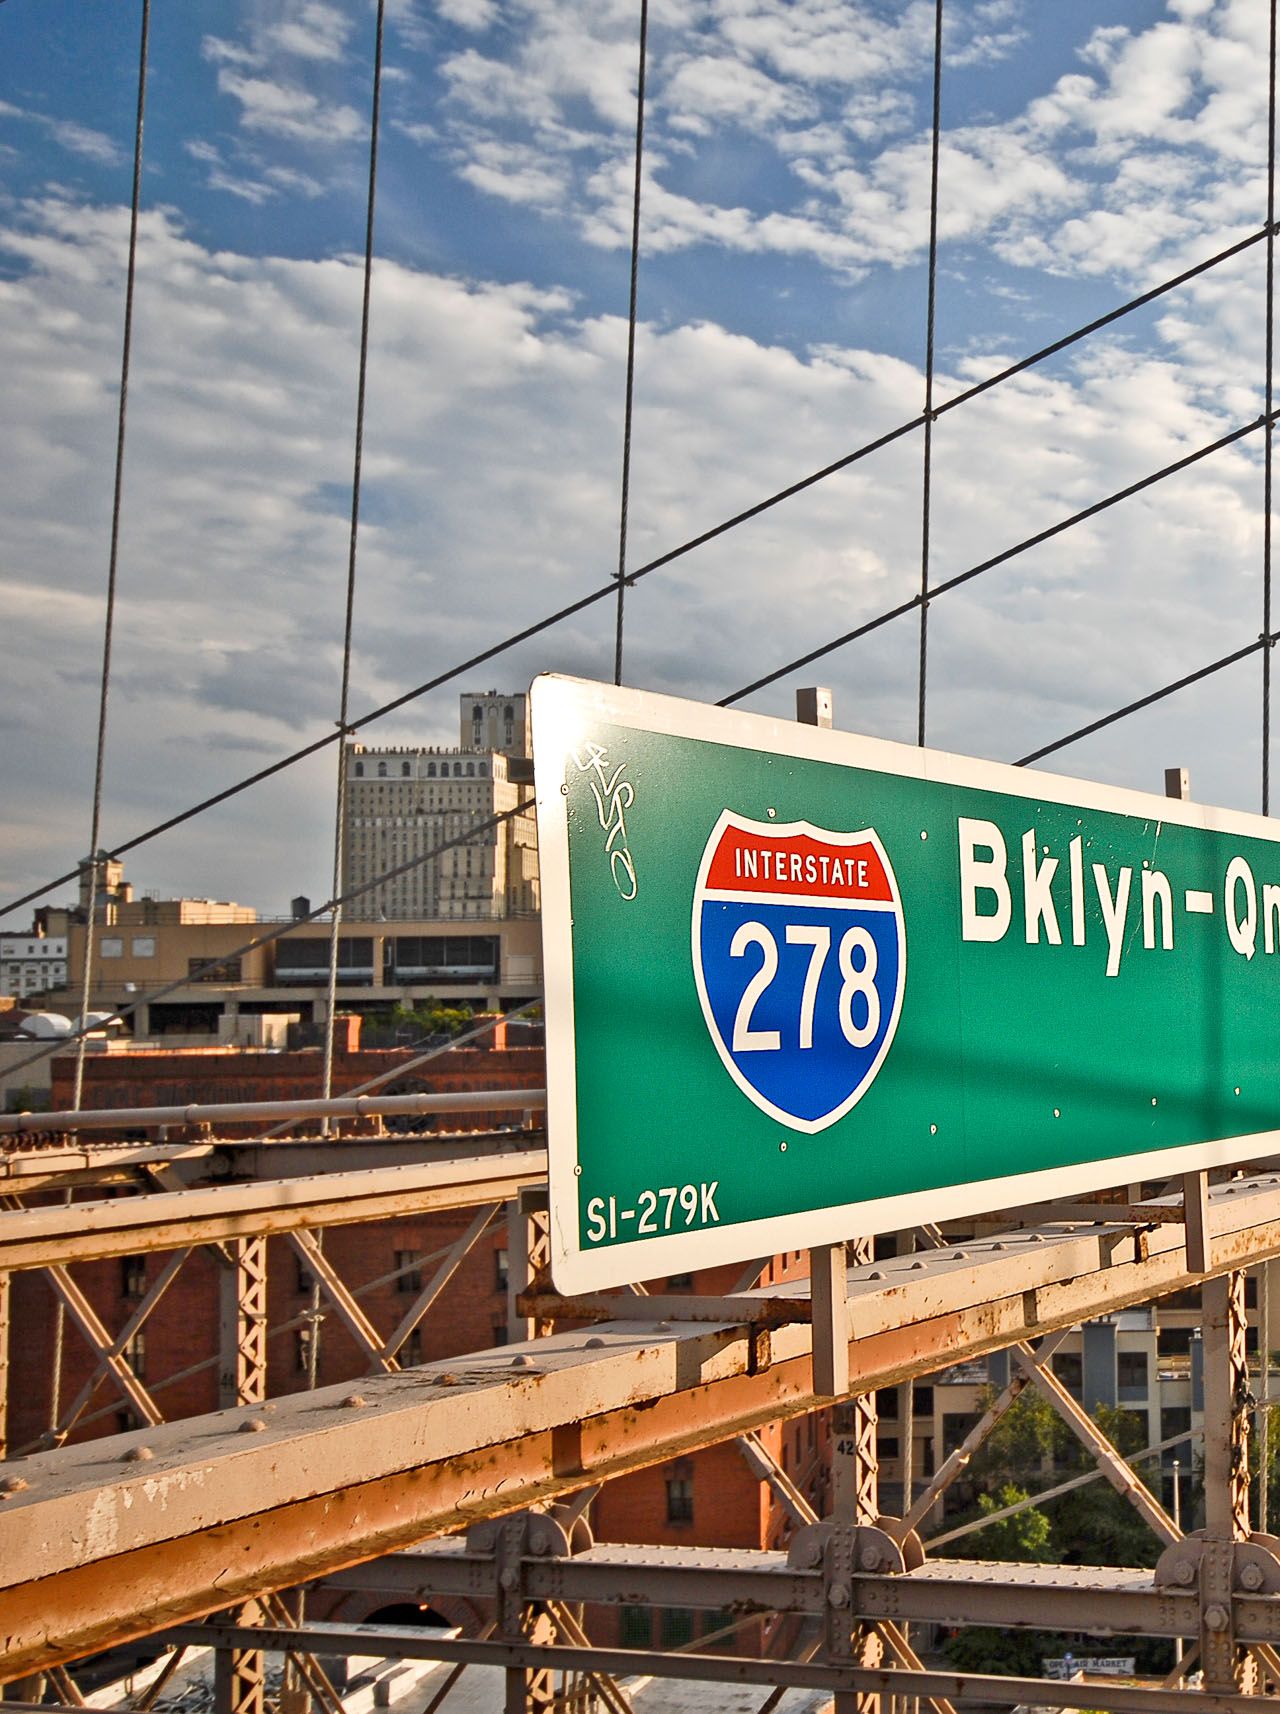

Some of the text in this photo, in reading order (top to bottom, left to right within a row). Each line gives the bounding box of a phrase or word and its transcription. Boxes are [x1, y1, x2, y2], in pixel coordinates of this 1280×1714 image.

[735, 847, 869, 888] INTERSTATE
[729, 920, 881, 1052] 278
[586, 1181, 720, 1242] SI-279K
[836, 1440, 854, 1456] 42
[1093, 1660, 1126, 1668] MARKET
